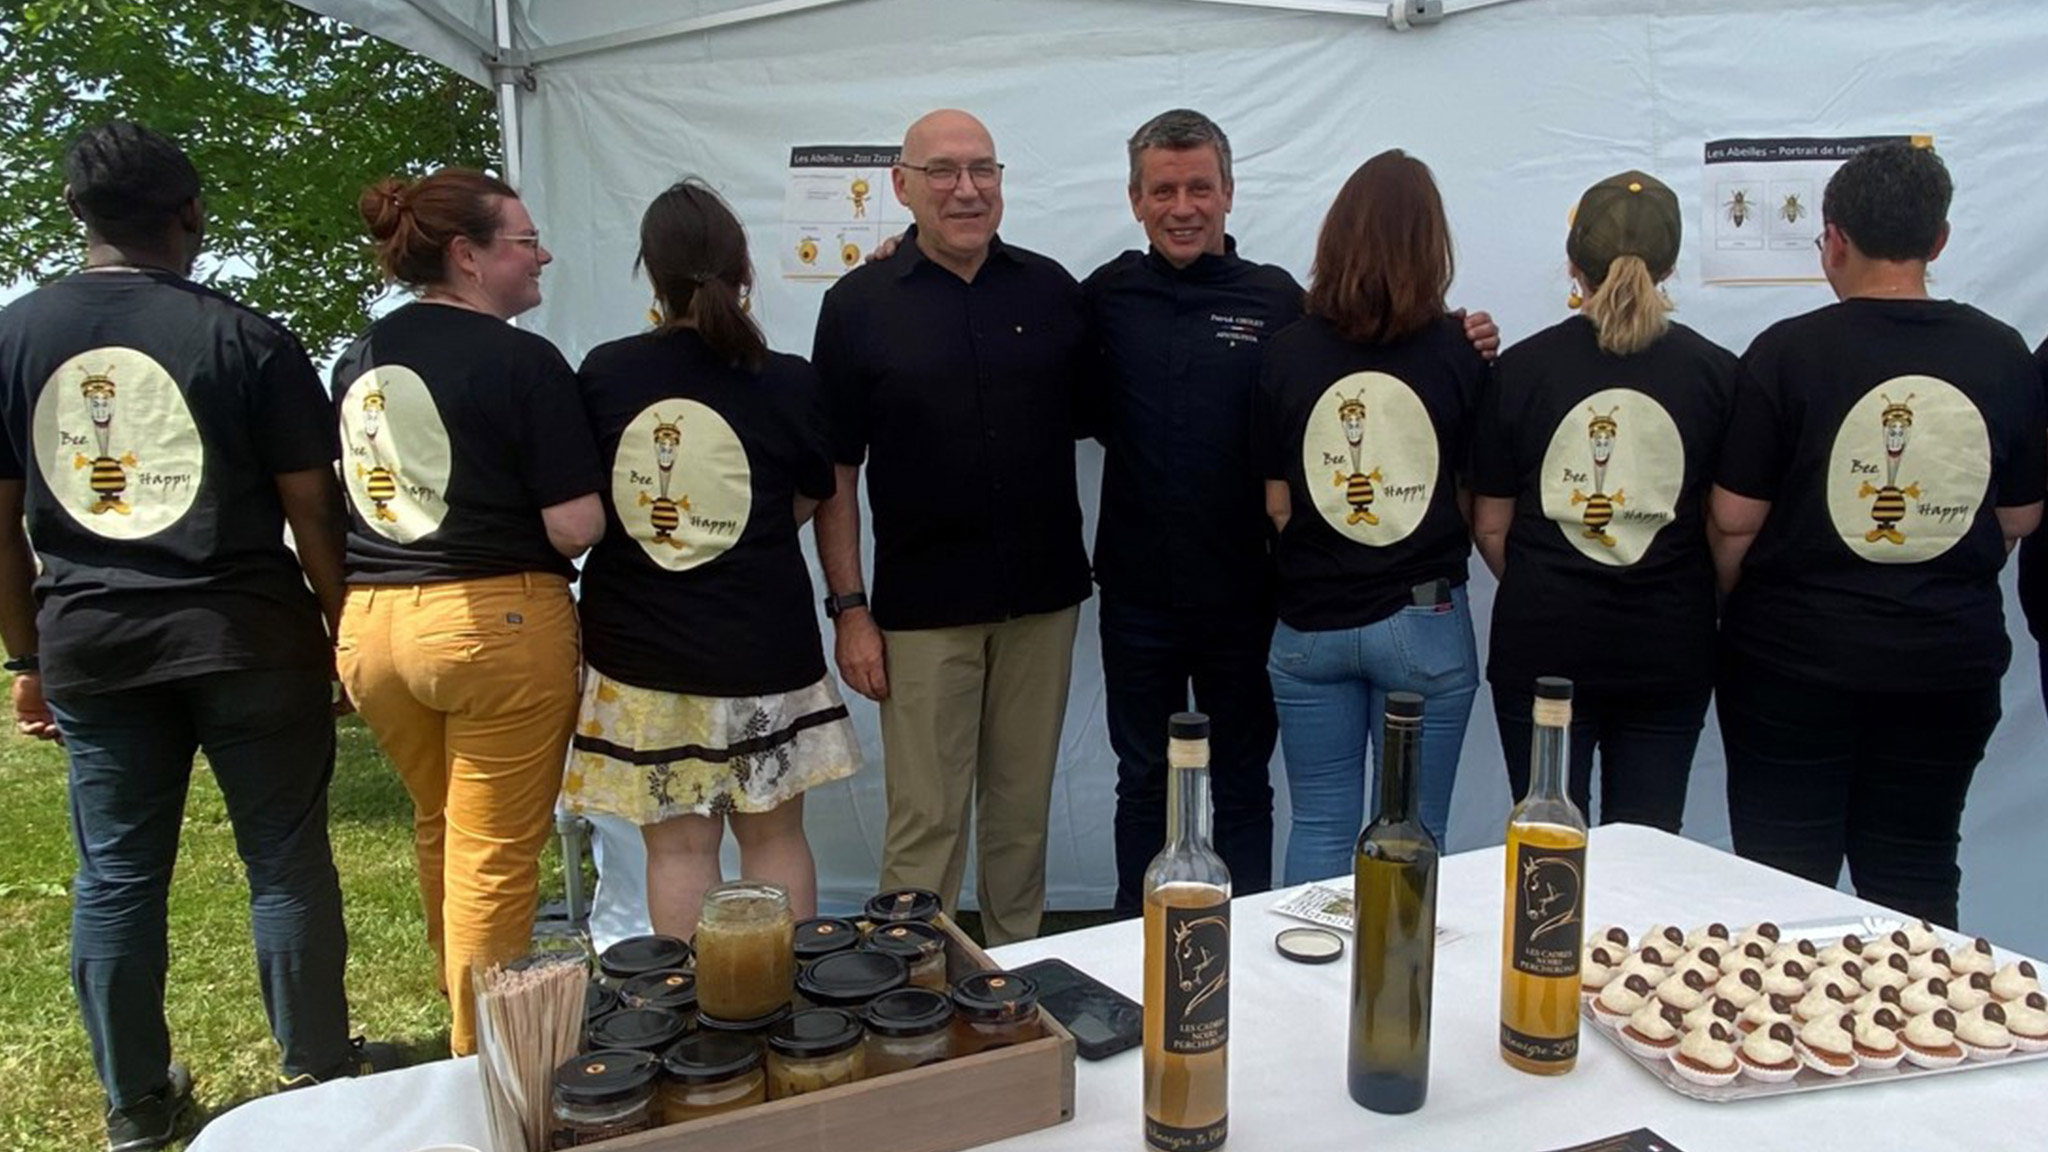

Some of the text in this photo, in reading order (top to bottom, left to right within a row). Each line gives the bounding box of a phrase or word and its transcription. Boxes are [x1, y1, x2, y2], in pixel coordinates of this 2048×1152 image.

[794, 153, 808, 163] Les
[810, 153, 844, 163] Abeilles
[1707, 149, 1724, 159] Les
[1726, 146, 1767, 157] Abeilles
[1779, 145, 1818, 155] Portrait
[1820, 145, 1834, 155] de
[60, 431, 88, 445] Bee
[1323, 452, 1346, 465] Bee
[1851, 459, 1879, 474] Bee
[138, 473, 191, 491] Happy
[630, 470, 653, 485] Bee
[1562, 468, 1588, 483] Bee
[1384, 484, 1426, 502] Happy
[1624, 509, 1668, 524] Happy
[1918, 503, 1969, 523] Happy
[690, 516, 737, 535] Happy
